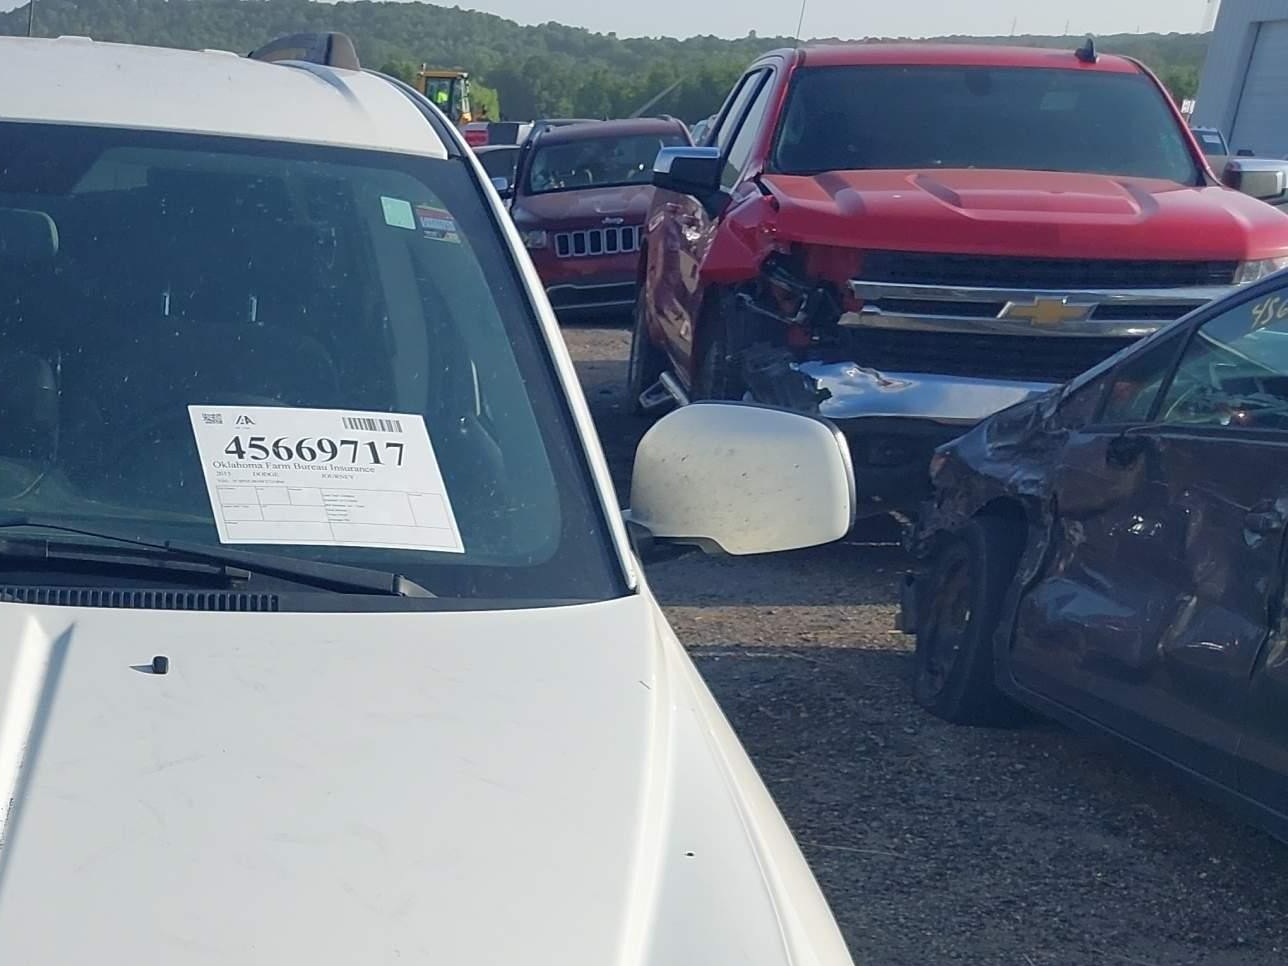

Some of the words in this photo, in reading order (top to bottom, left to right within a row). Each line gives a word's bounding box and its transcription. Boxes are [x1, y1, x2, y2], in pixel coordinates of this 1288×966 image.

[224, 435, 404, 466] 45669717
[212, 461, 263, 469] Oklahoma
[266, 462, 291, 470] Farm
[294, 463, 328, 472] Bureau
[330, 464, 375, 473] Insurance
